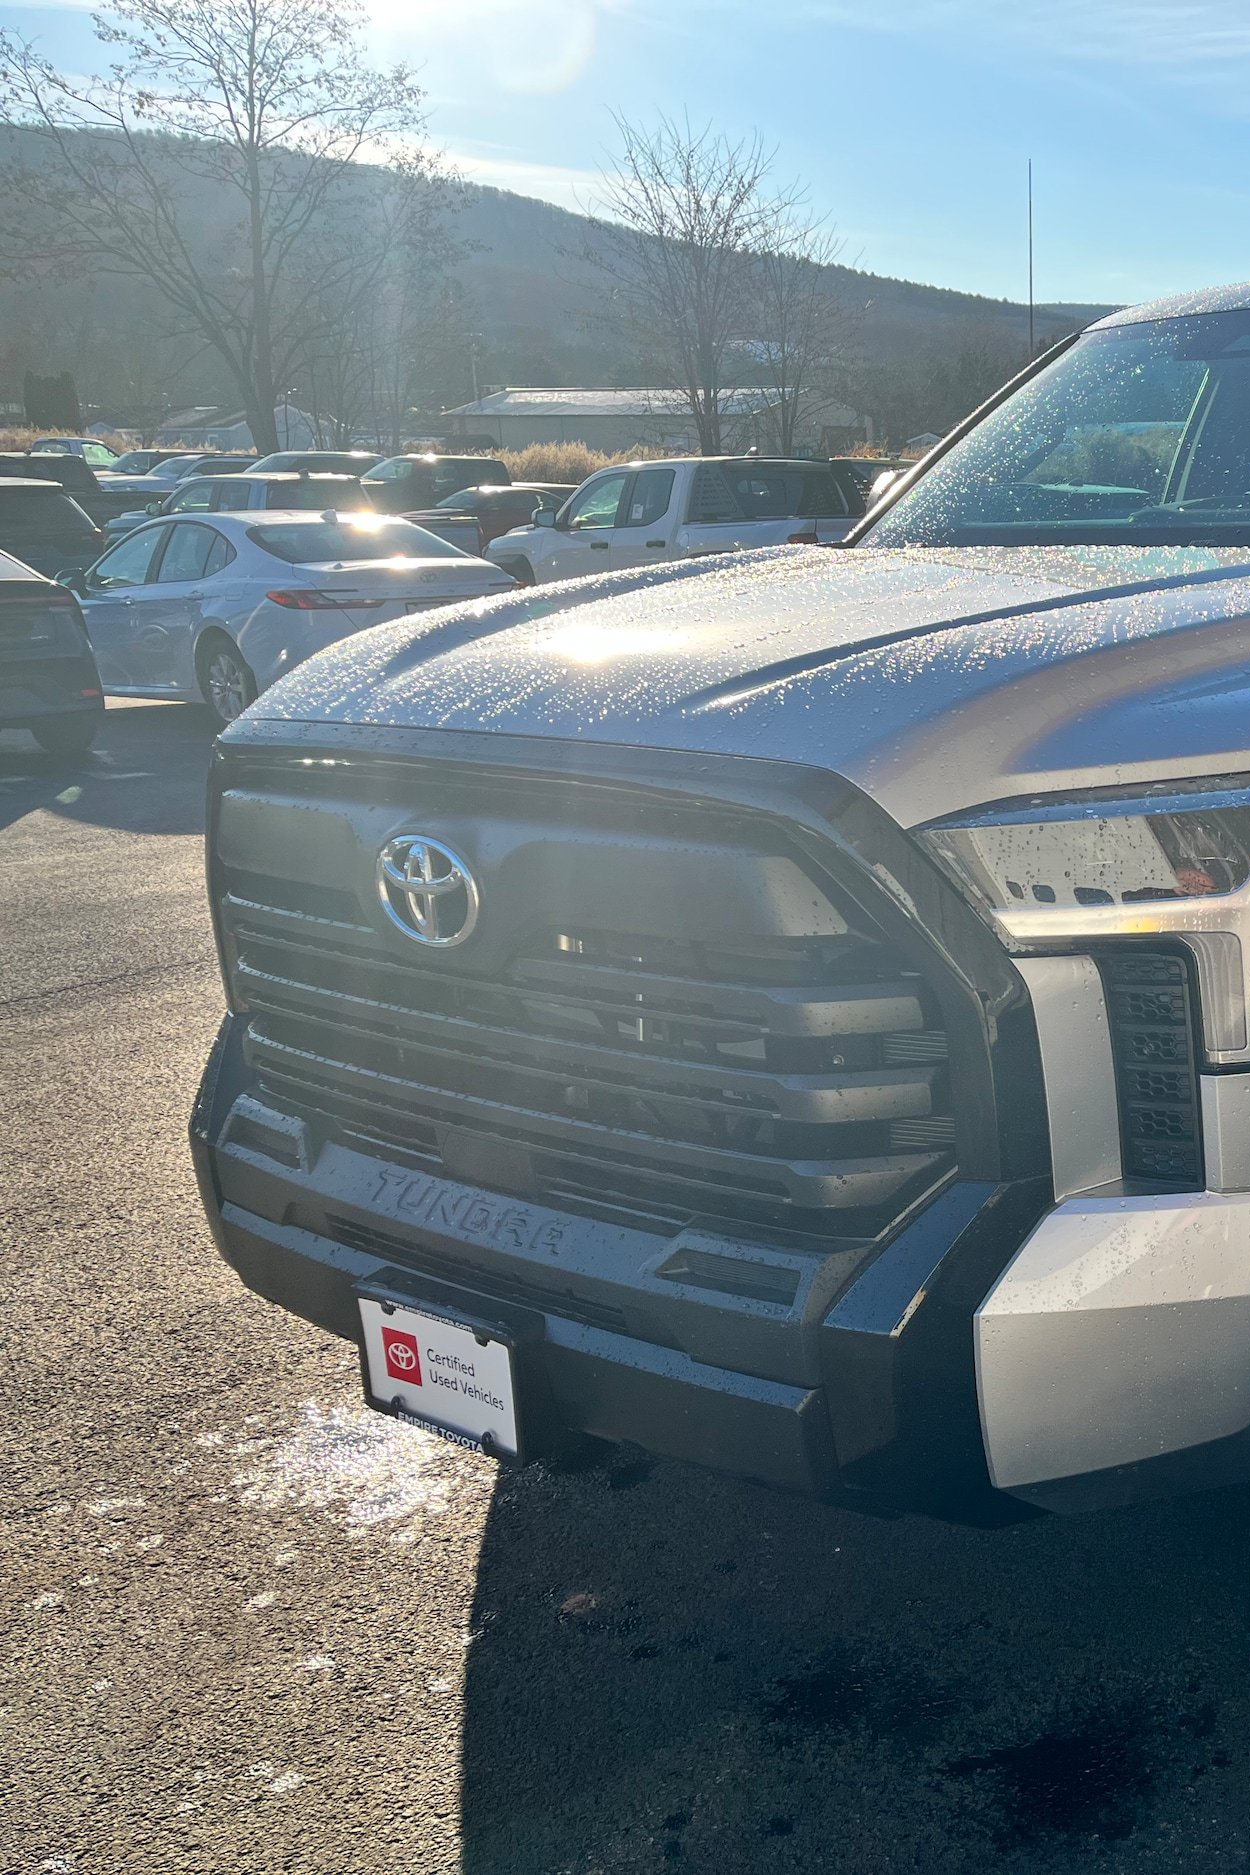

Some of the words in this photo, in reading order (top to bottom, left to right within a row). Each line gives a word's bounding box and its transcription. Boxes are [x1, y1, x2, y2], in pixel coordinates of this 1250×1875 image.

[371, 1168, 572, 1255] TUNDRA
[426, 1348, 475, 1377] Certified
[429, 1369, 458, 1391] Used
[459, 1379, 505, 1411] Vehicles
[397, 1411, 439, 1434] EMPIRE
[439, 1428, 485, 1454] TOYOTA
